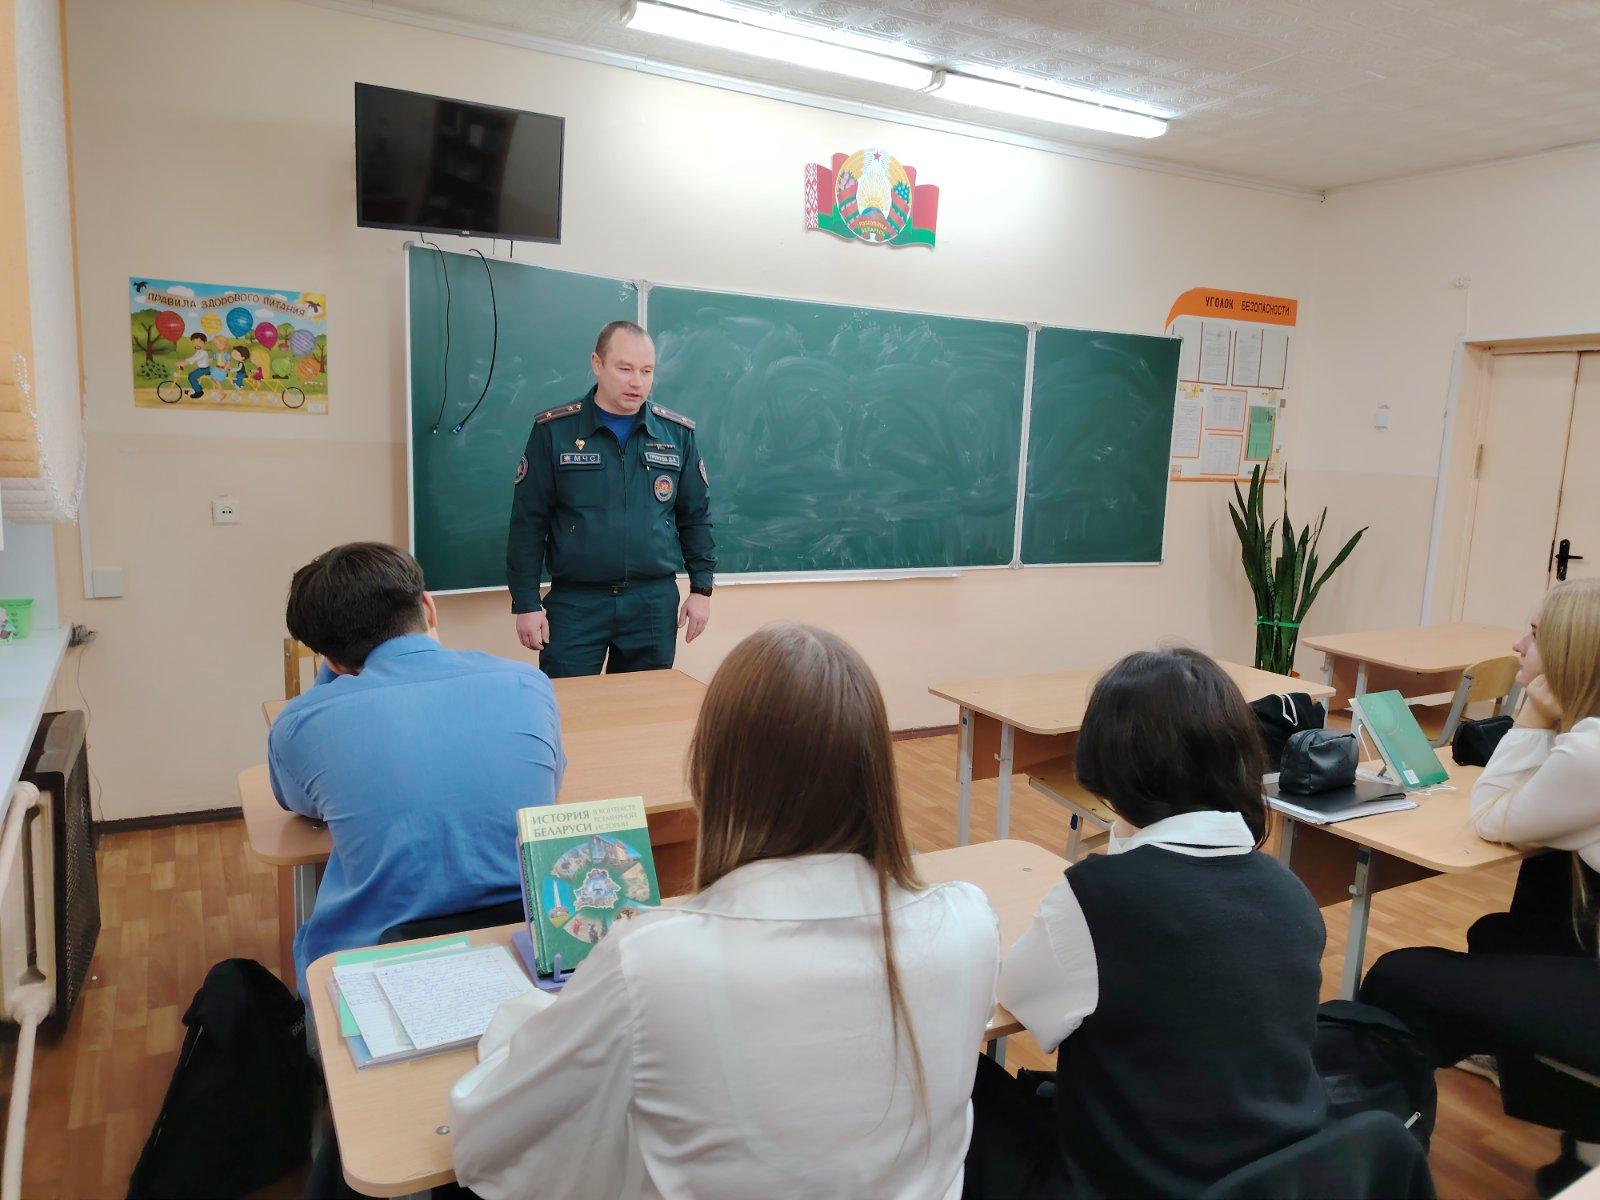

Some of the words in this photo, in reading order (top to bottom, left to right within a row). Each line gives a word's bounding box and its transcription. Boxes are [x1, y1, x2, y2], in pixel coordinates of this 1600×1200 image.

[147, 292, 197, 309] ПРАВИЛА
[201, 292, 260, 309] ЗДОРОВОГО
[263, 297, 306, 317] ПИТАНИЯ
[1205, 296, 1234, 310] УГОЛОК
[1241, 300, 1290, 316] БЕЗОПАСНОСТИ
[531, 809, 591, 825] ИСТОРИЯ
[533, 822, 593, 838] БЕЛАРУСИ
